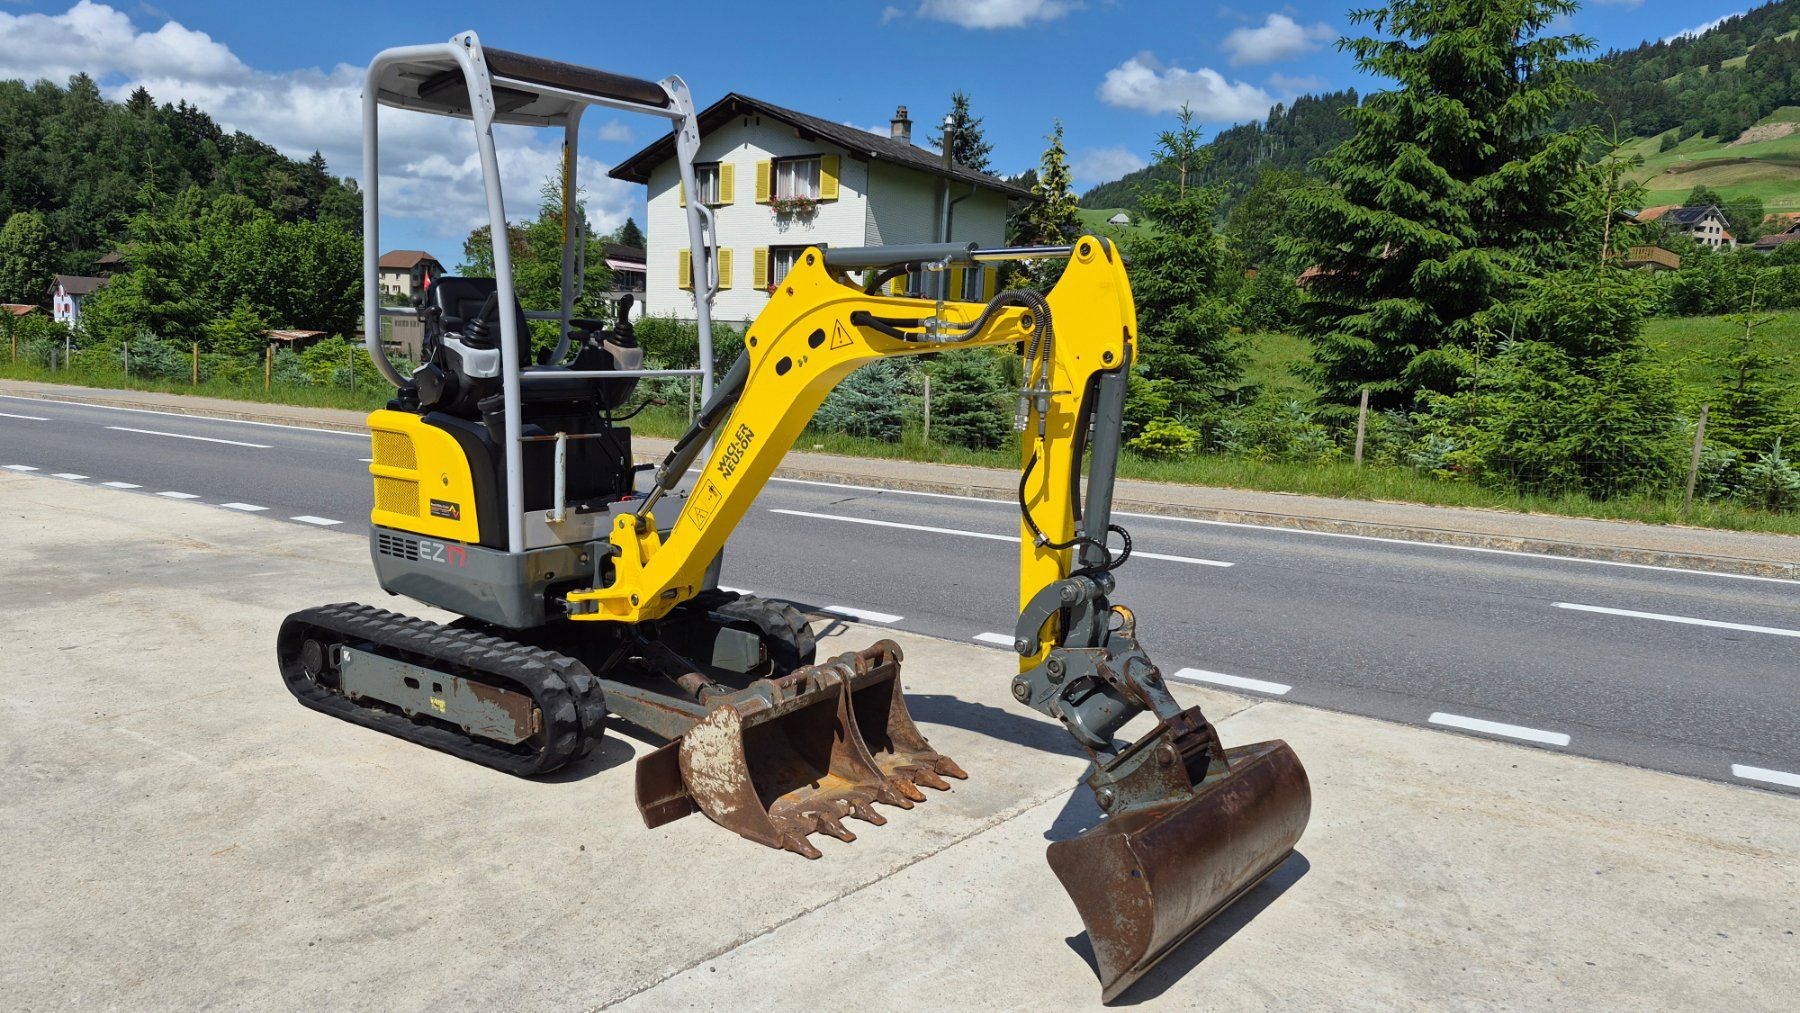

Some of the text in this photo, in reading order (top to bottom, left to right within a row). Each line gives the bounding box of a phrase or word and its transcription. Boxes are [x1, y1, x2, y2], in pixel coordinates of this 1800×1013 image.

[717, 423, 748, 472] WACKER
[722, 429, 755, 480] NEUSON
[420, 540, 466, 568] EZ17
